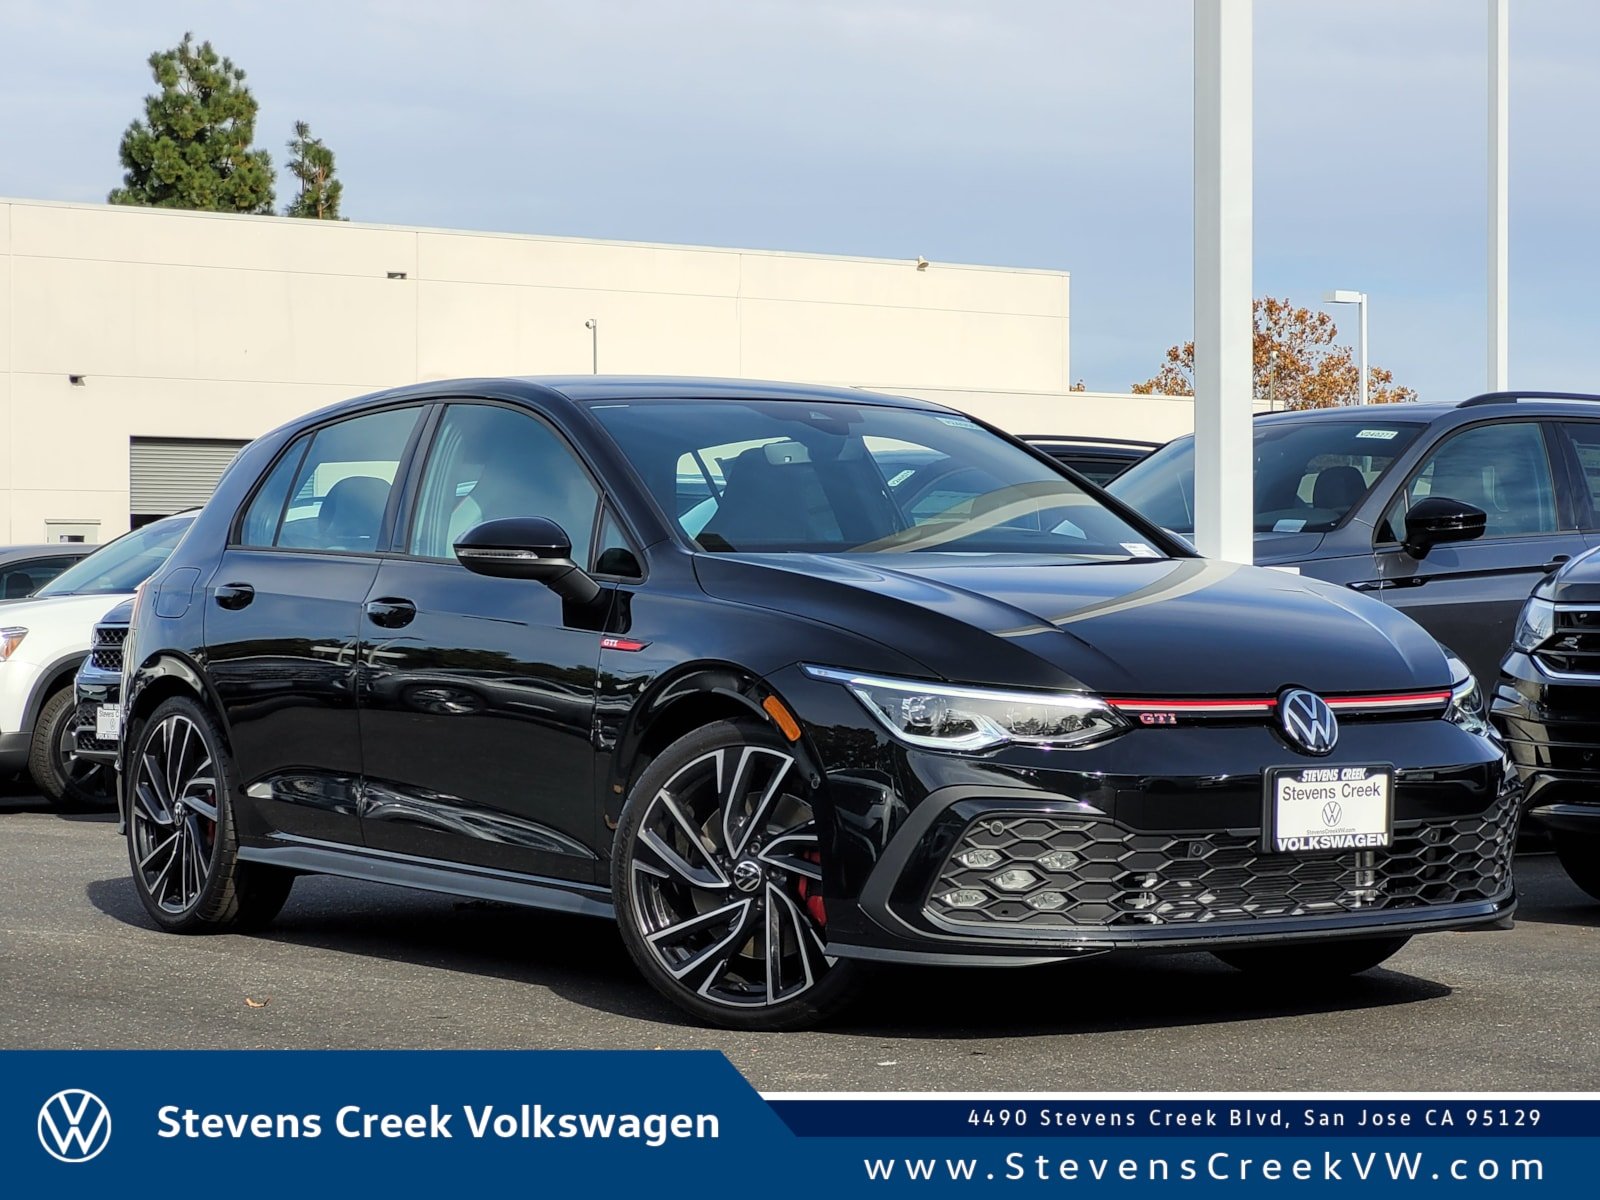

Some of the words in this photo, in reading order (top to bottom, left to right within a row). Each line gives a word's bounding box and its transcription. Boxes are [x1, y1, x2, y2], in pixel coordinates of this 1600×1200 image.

[603, 638, 619, 647] GTI
[1138, 712, 1178, 725] GTI
[1301, 768, 1339, 782] STEVENS
[1340, 767, 1368, 781] CREEK
[1282, 785, 1337, 801] Stevens
[1341, 782, 1381, 798] Creek
[1276, 833, 1389, 851] VOLKSWAGEN
